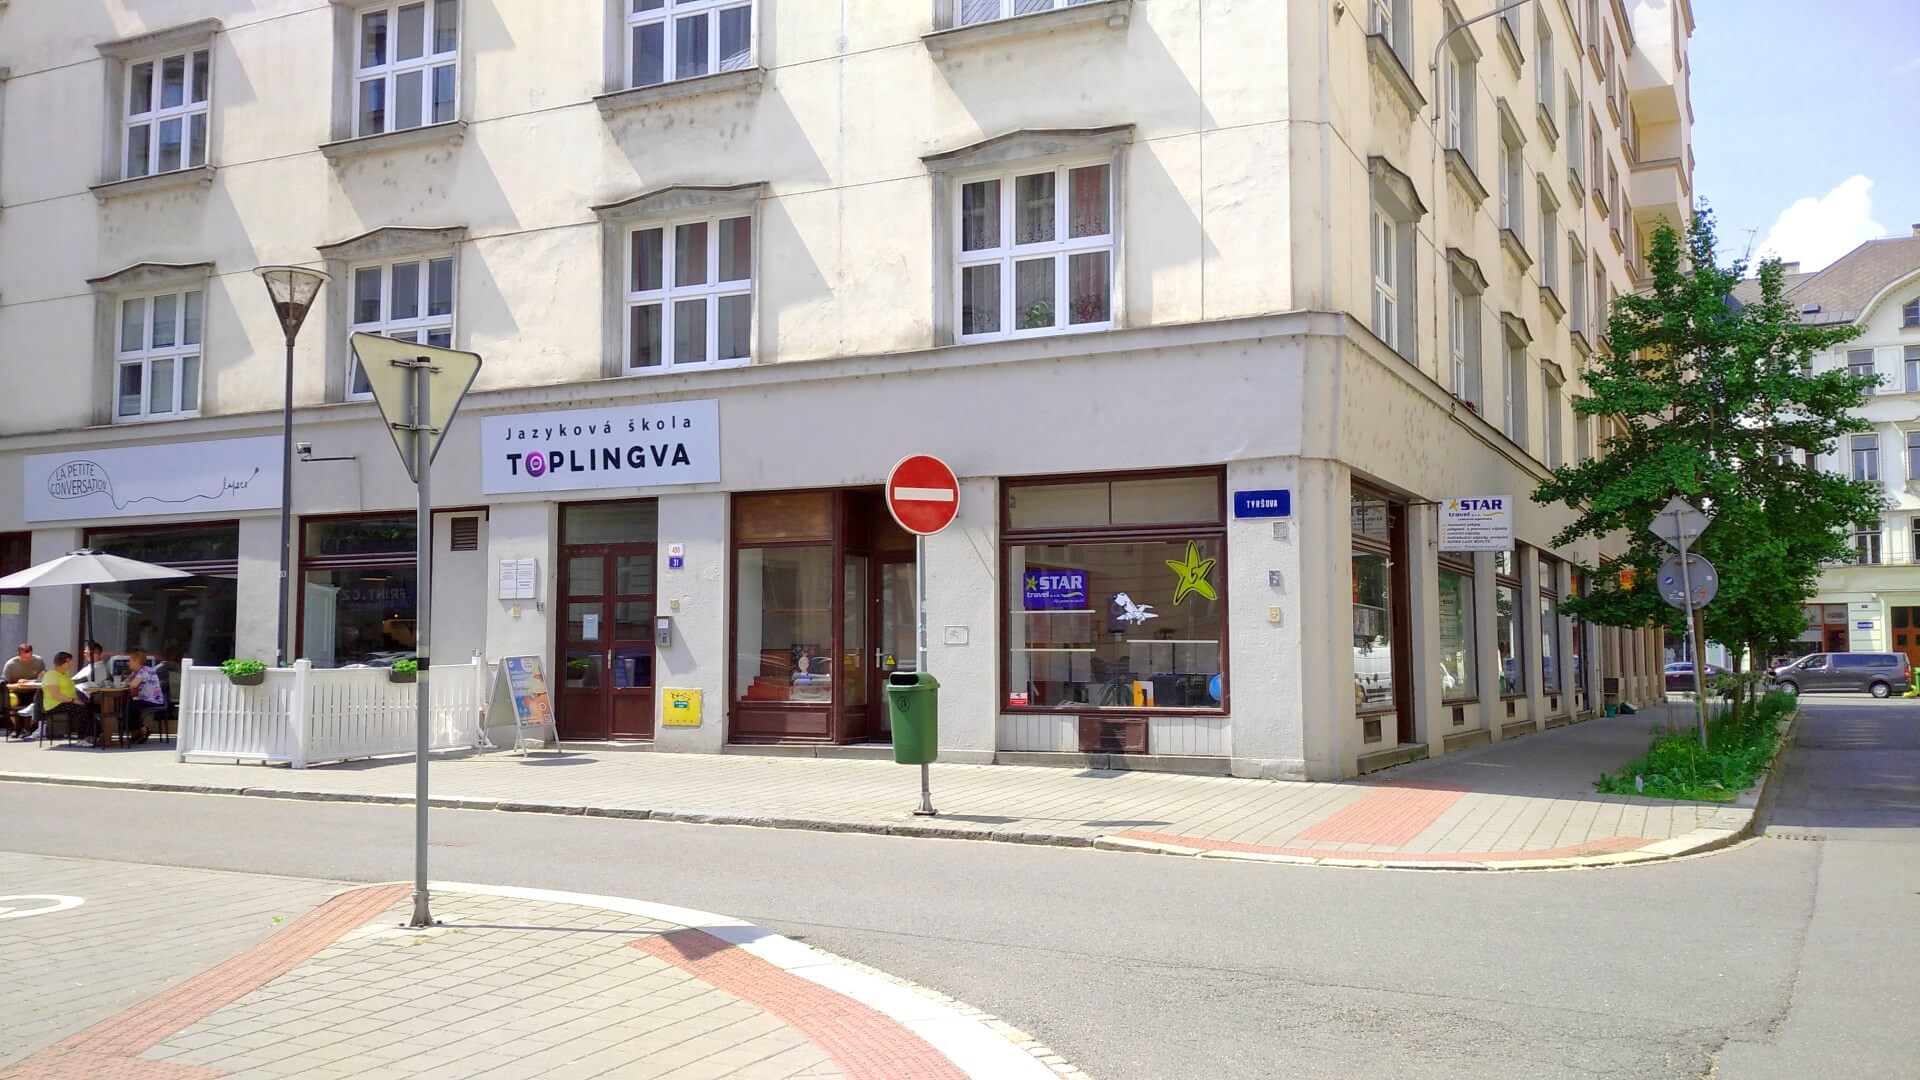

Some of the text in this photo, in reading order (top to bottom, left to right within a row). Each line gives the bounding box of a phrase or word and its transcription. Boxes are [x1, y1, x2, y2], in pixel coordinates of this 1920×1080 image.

[506, 415, 691, 441] Jazyková škola
[506, 443, 691, 477] TOPLINGVA
[56, 463, 95, 481] LA PETITE
[51, 478, 106, 495] CONVERSATION
[1461, 499, 1502, 511] STAR
[1039, 575, 1082, 590] STAR
